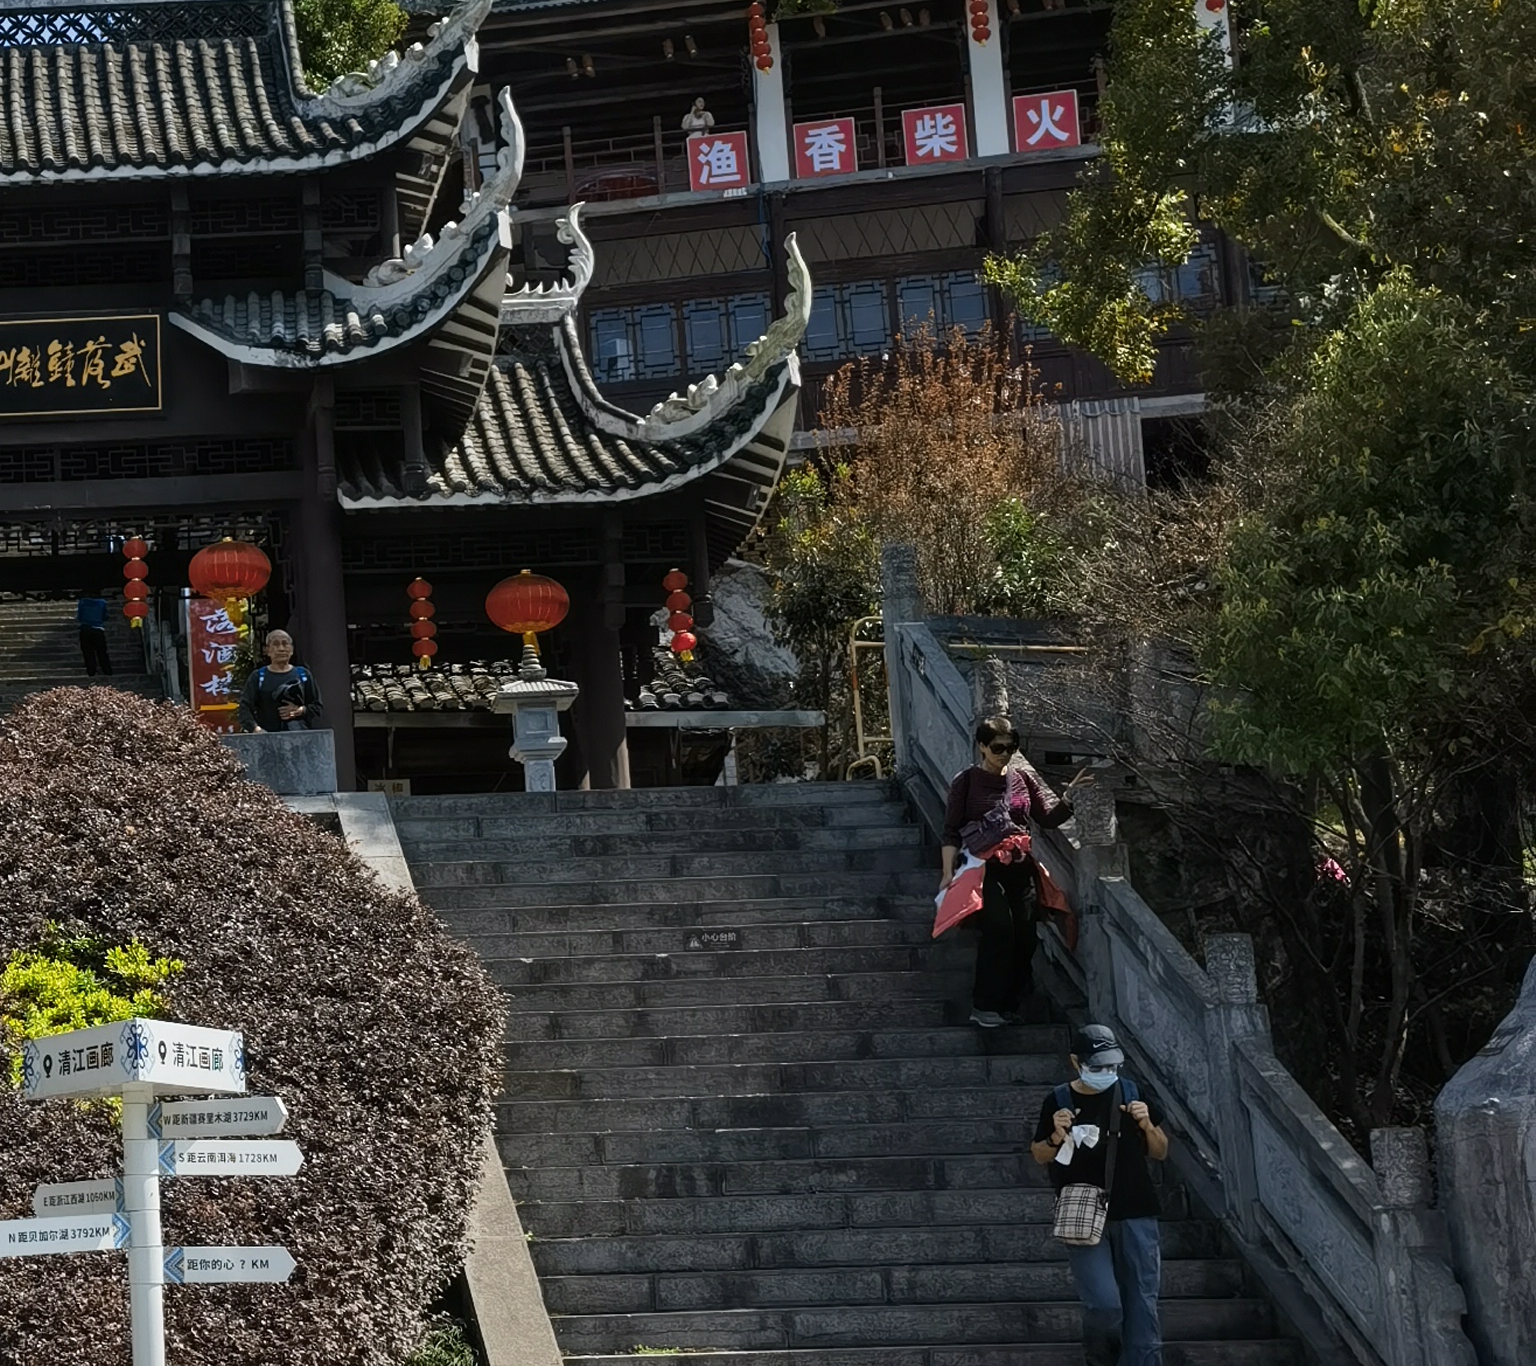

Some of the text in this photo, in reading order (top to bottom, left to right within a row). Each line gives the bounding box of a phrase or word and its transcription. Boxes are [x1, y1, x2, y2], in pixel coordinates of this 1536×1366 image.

[697, 98, 1070, 185] 渔香柴火
[58, 1041, 114, 1076] 清江画廊
[172, 1041, 224, 1073] 清江画廊
[233, 1110, 268, 1123] 3729KM
[179, 1152, 278, 1163] S 距云南洱海 1728KM
[8, 1226, 110, 1243] N 距贝加尔湖 3792KM
[187, 1258, 235, 1271] 距你的心
[251, 1259, 270, 1269] KM
